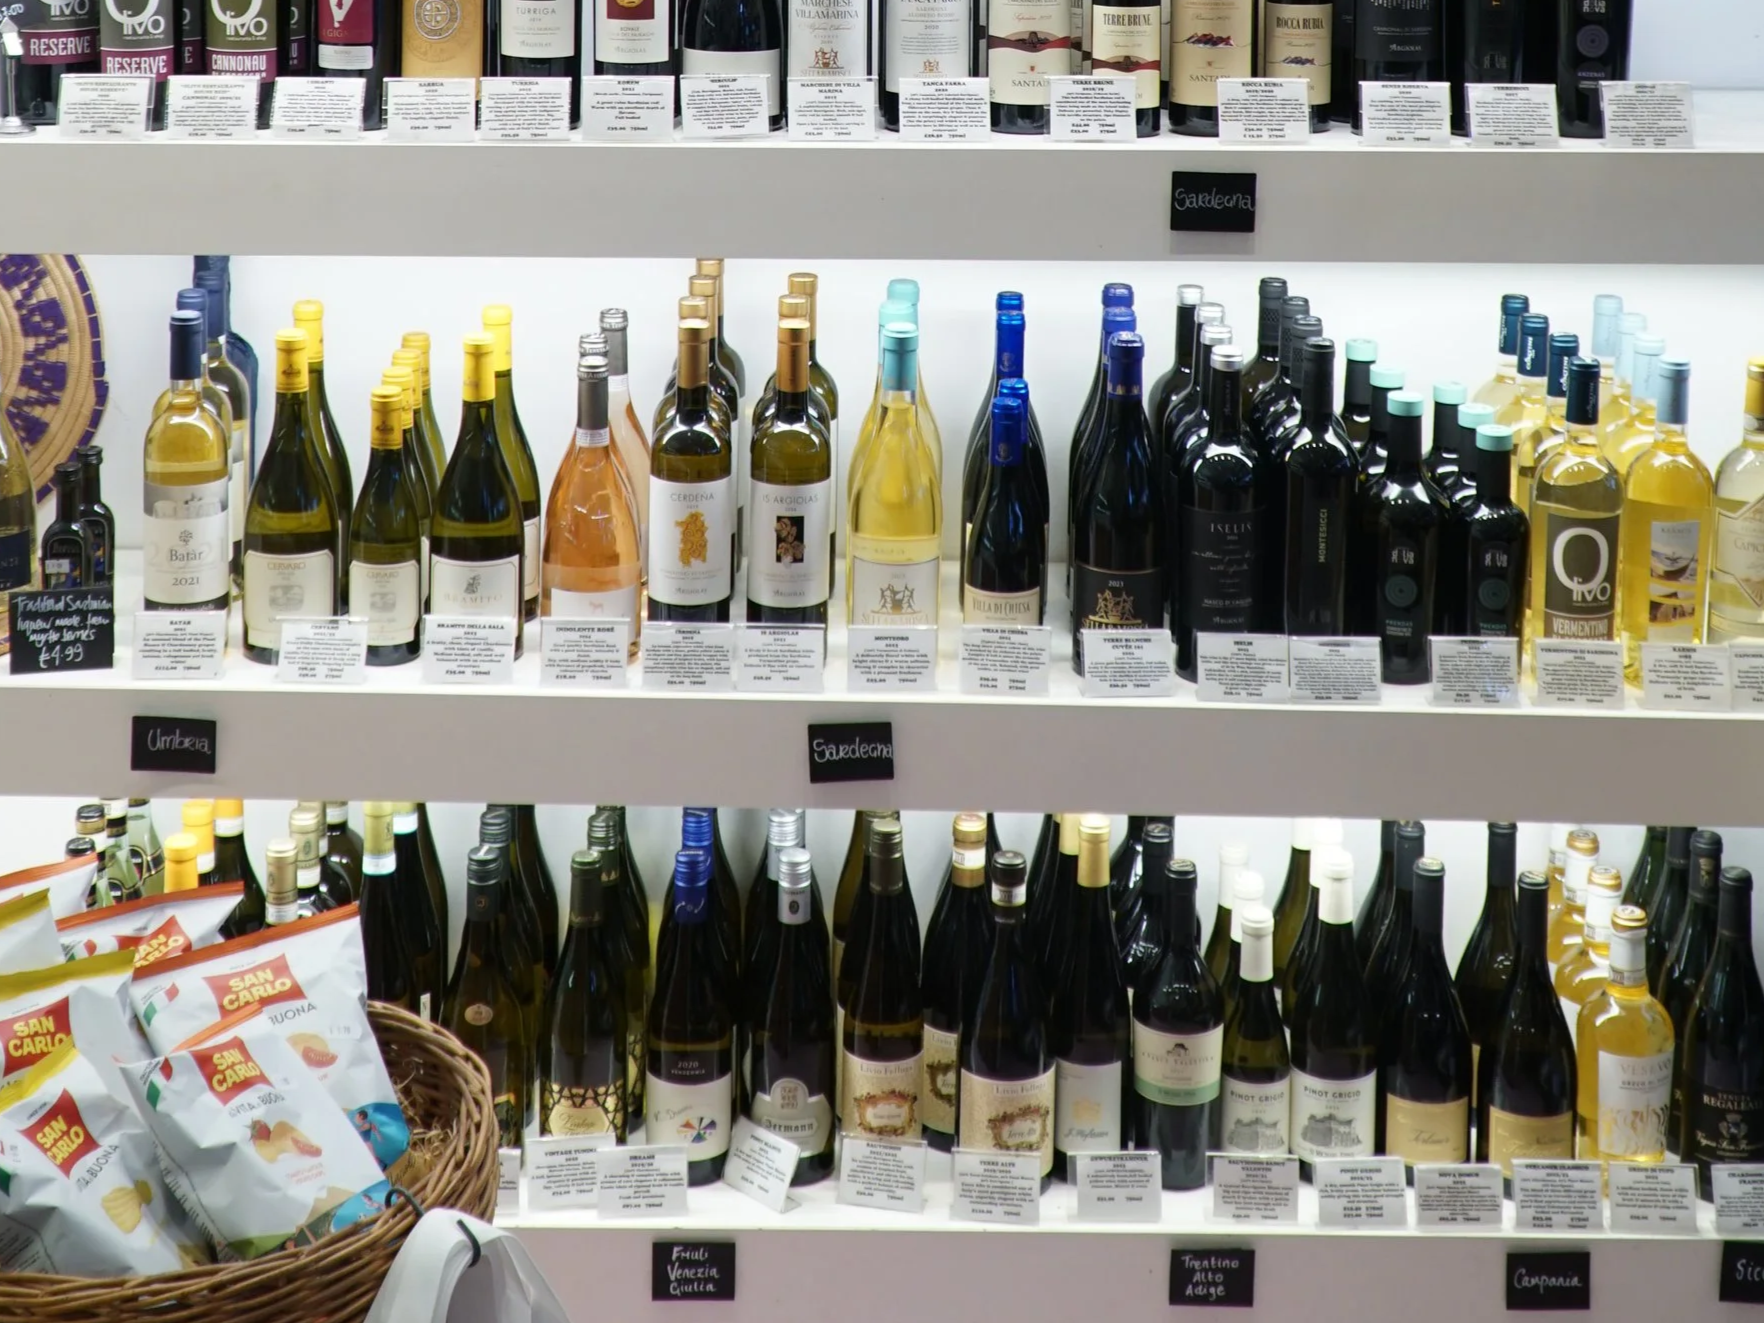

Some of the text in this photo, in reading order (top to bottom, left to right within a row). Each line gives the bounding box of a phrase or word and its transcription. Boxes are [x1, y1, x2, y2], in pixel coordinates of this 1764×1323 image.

[515, 6, 557, 16] TURRIGA
[795, 9, 859, 20] VILLAMARINA
[1102, 12, 1152, 26] TERRE BRUNE
[1276, 16, 1324, 30] ROCCA RUBIA
[30, 35, 91, 56] RESERVE
[106, 54, 167, 76] RESERVE
[212, 52, 267, 73] CANNONAU
[670, 490, 715, 502] CERDEÑA
[772, 494, 819, 505] ARGIOLAS
[1318, 508, 1328, 564] MONTESICCI
[169, 547, 203, 563] Batàr
[266, 561, 306, 571] CERVARO
[171, 577, 200, 587] 2021
[972, 596, 1031, 617] VILLA DI CHIESA
[1552, 617, 1609, 634] VERMENTINO
[39, 643, 84, 669] £4.99
[228, 966, 275, 992] SAN
[222, 977, 292, 1011] CARLO
[13, 1015, 55, 1038] SAN
[212, 1046, 244, 1070] SAN
[677, 1060, 699, 1069] 2020
[211, 1060, 261, 1092] CARLO
[860, 1062, 880, 1074] Livio
[1230, 1090, 1285, 1103] PINOT GRIGIO
[1303, 1085, 1362, 1099] PINOT GRIGIO
[36, 1114, 68, 1149] SAN
[764, 1118, 815, 1134] Jermann
[46, 1125, 85, 1166] CARLO
[667, 1262, 720, 1280] Venezia
[1181, 1254, 1240, 1271] Trentino
[1192, 1270, 1224, 1283] Alto
[1513, 1267, 1582, 1294] Campania
[669, 1280, 717, 1297] Giulia
[1185, 1283, 1226, 1301] Adige
